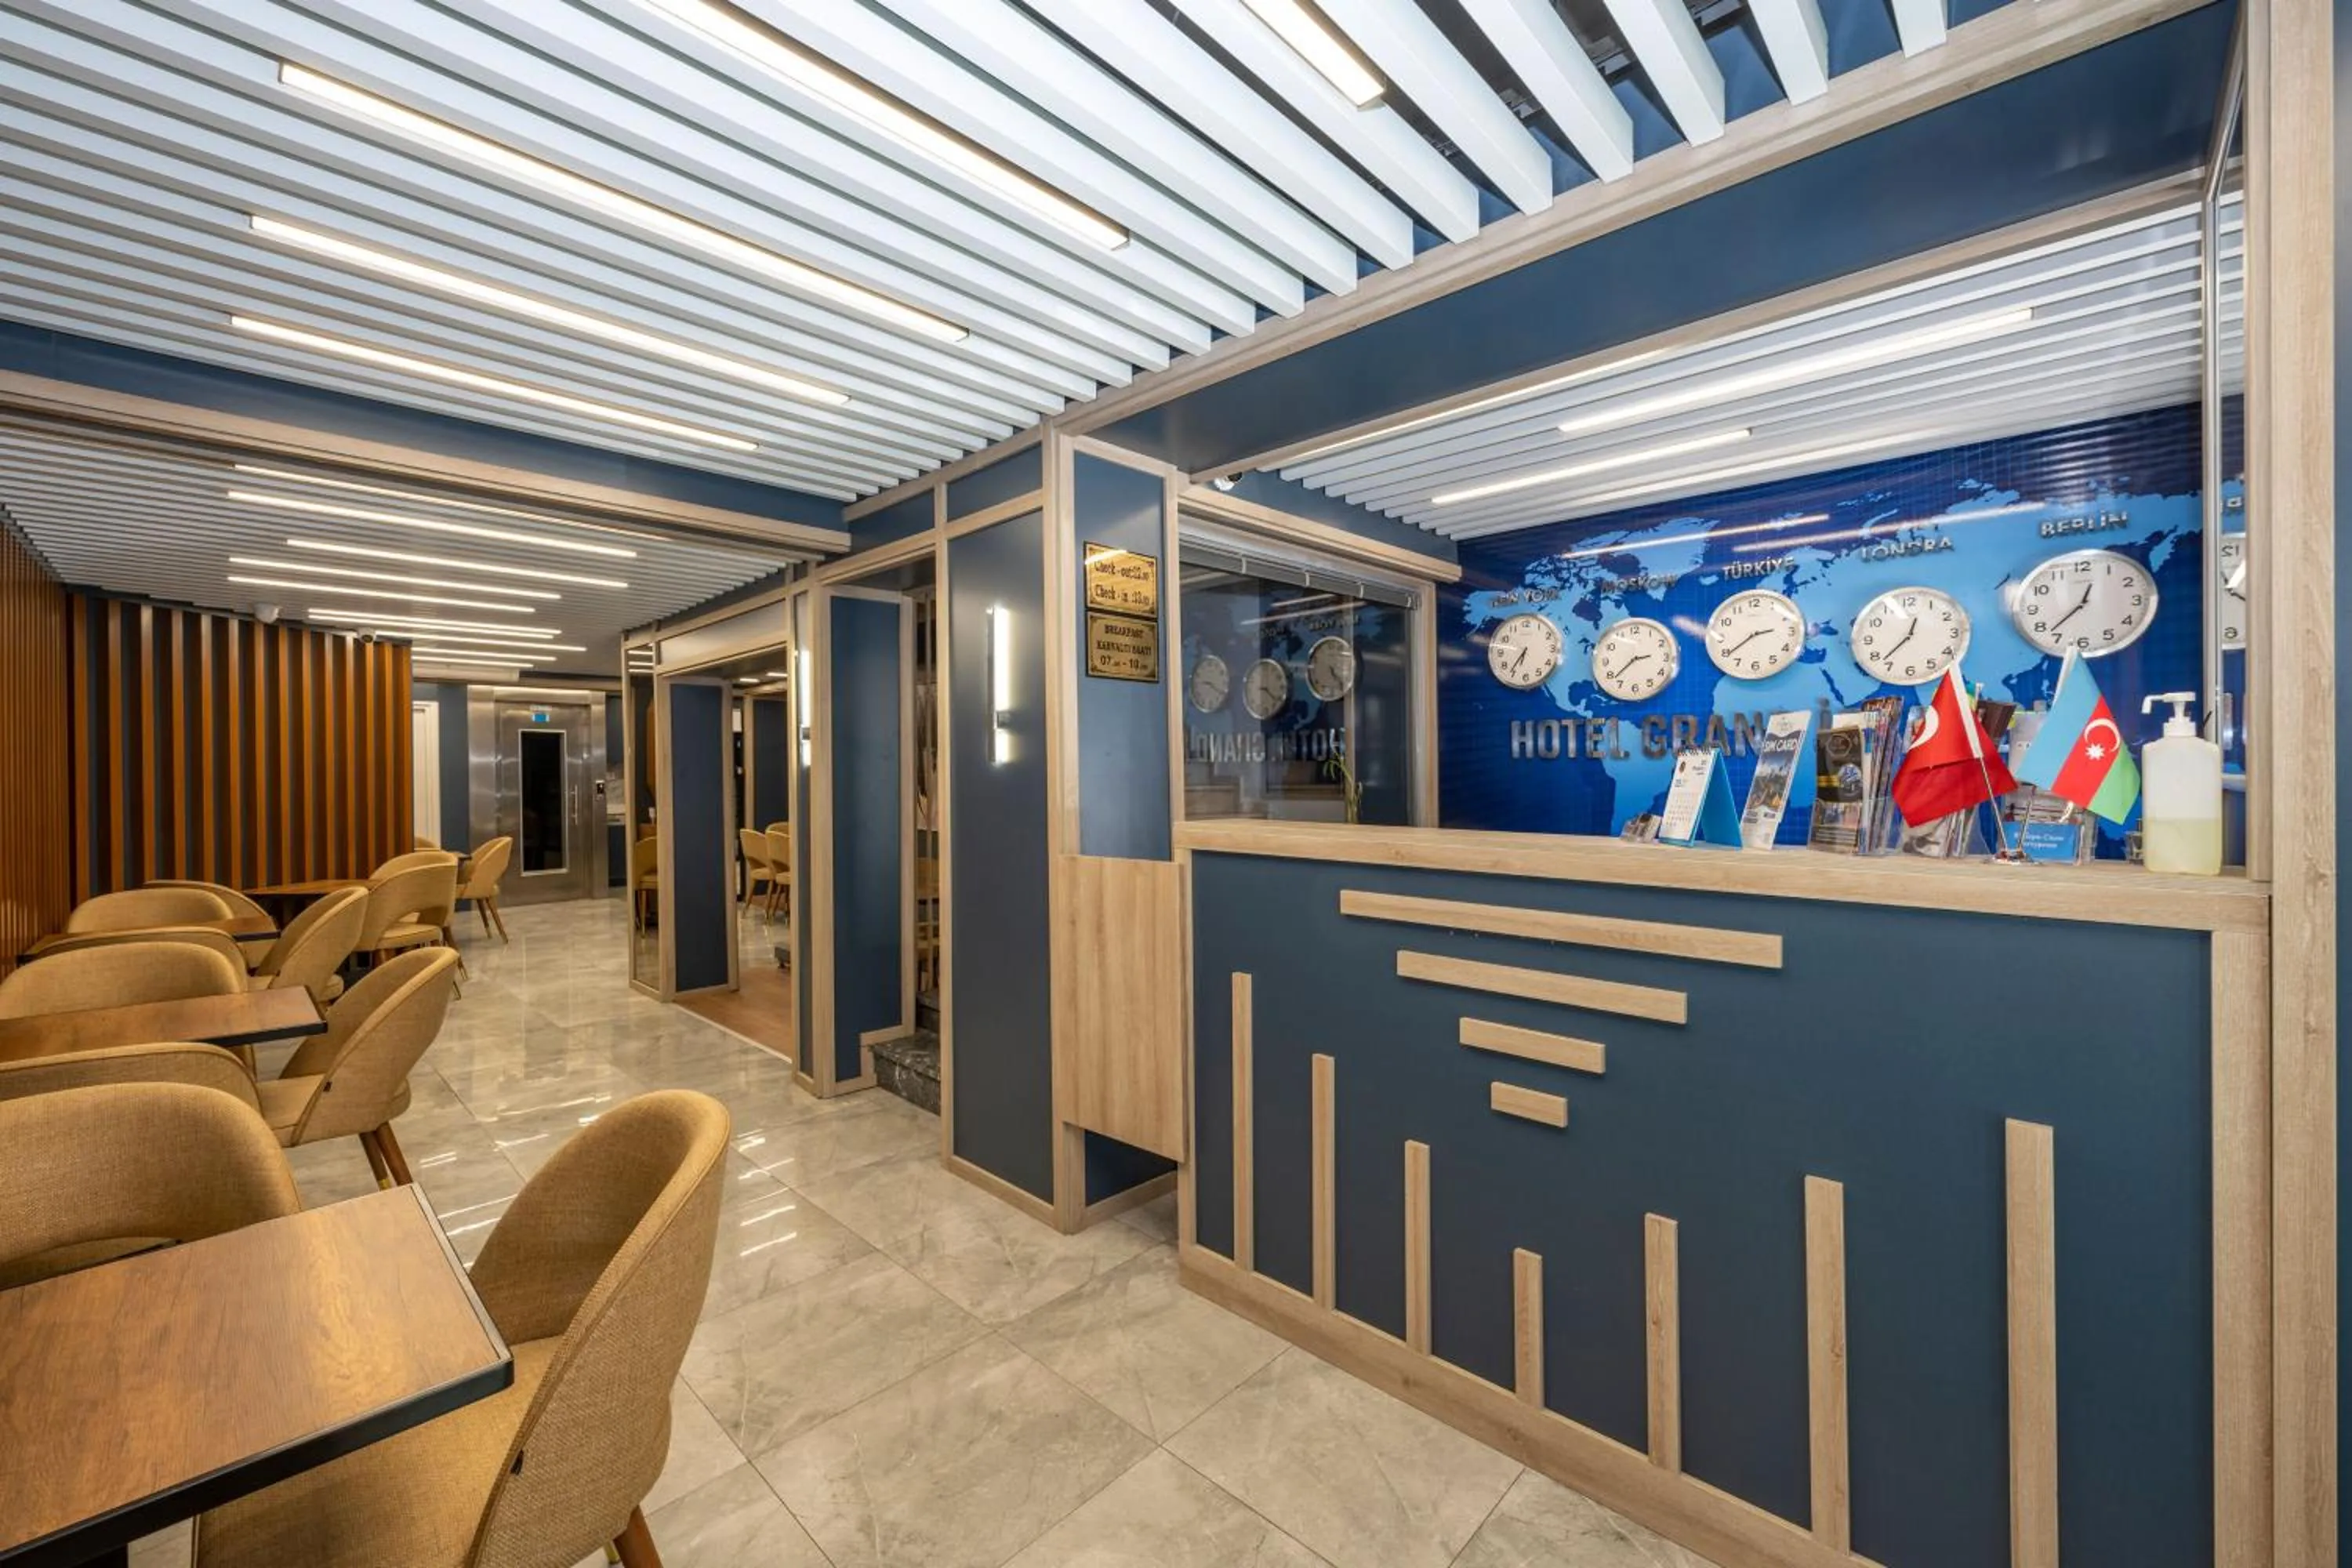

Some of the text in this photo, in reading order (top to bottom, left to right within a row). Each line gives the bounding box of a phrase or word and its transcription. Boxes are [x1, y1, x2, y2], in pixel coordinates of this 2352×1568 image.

[1722, 556, 1795, 580] TÜRKİYE
[1511, 717, 1630, 760] HOTEL
[1642, 710, 1773, 760] GRAN
